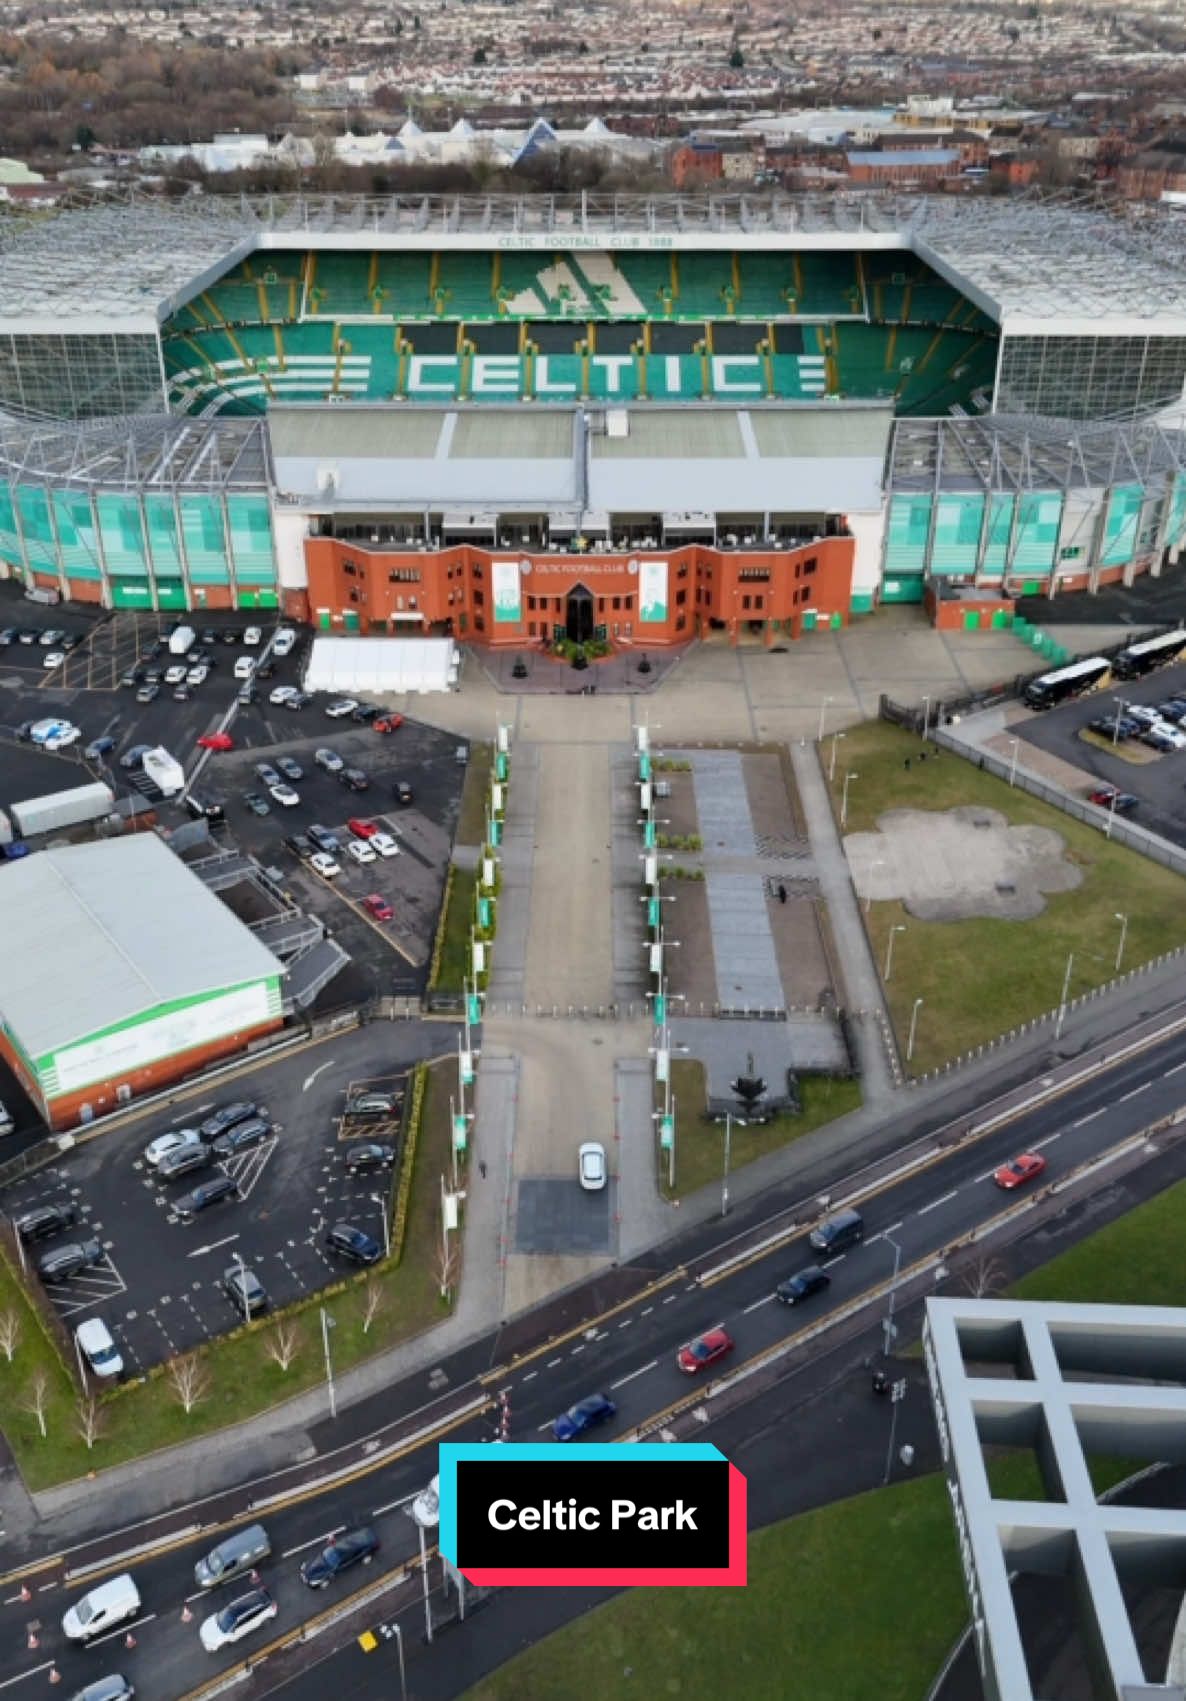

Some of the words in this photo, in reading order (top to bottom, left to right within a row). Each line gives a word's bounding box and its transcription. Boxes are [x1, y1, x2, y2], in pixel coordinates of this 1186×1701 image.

[499, 236, 535, 248] CELTIC
[545, 236, 600, 248] FOOTBALL
[610, 236, 640, 248] CLUB
[407, 355, 761, 392] CELTIC
[535, 563, 560, 573] CELTIC
[562, 563, 600, 573] FOOTBALL
